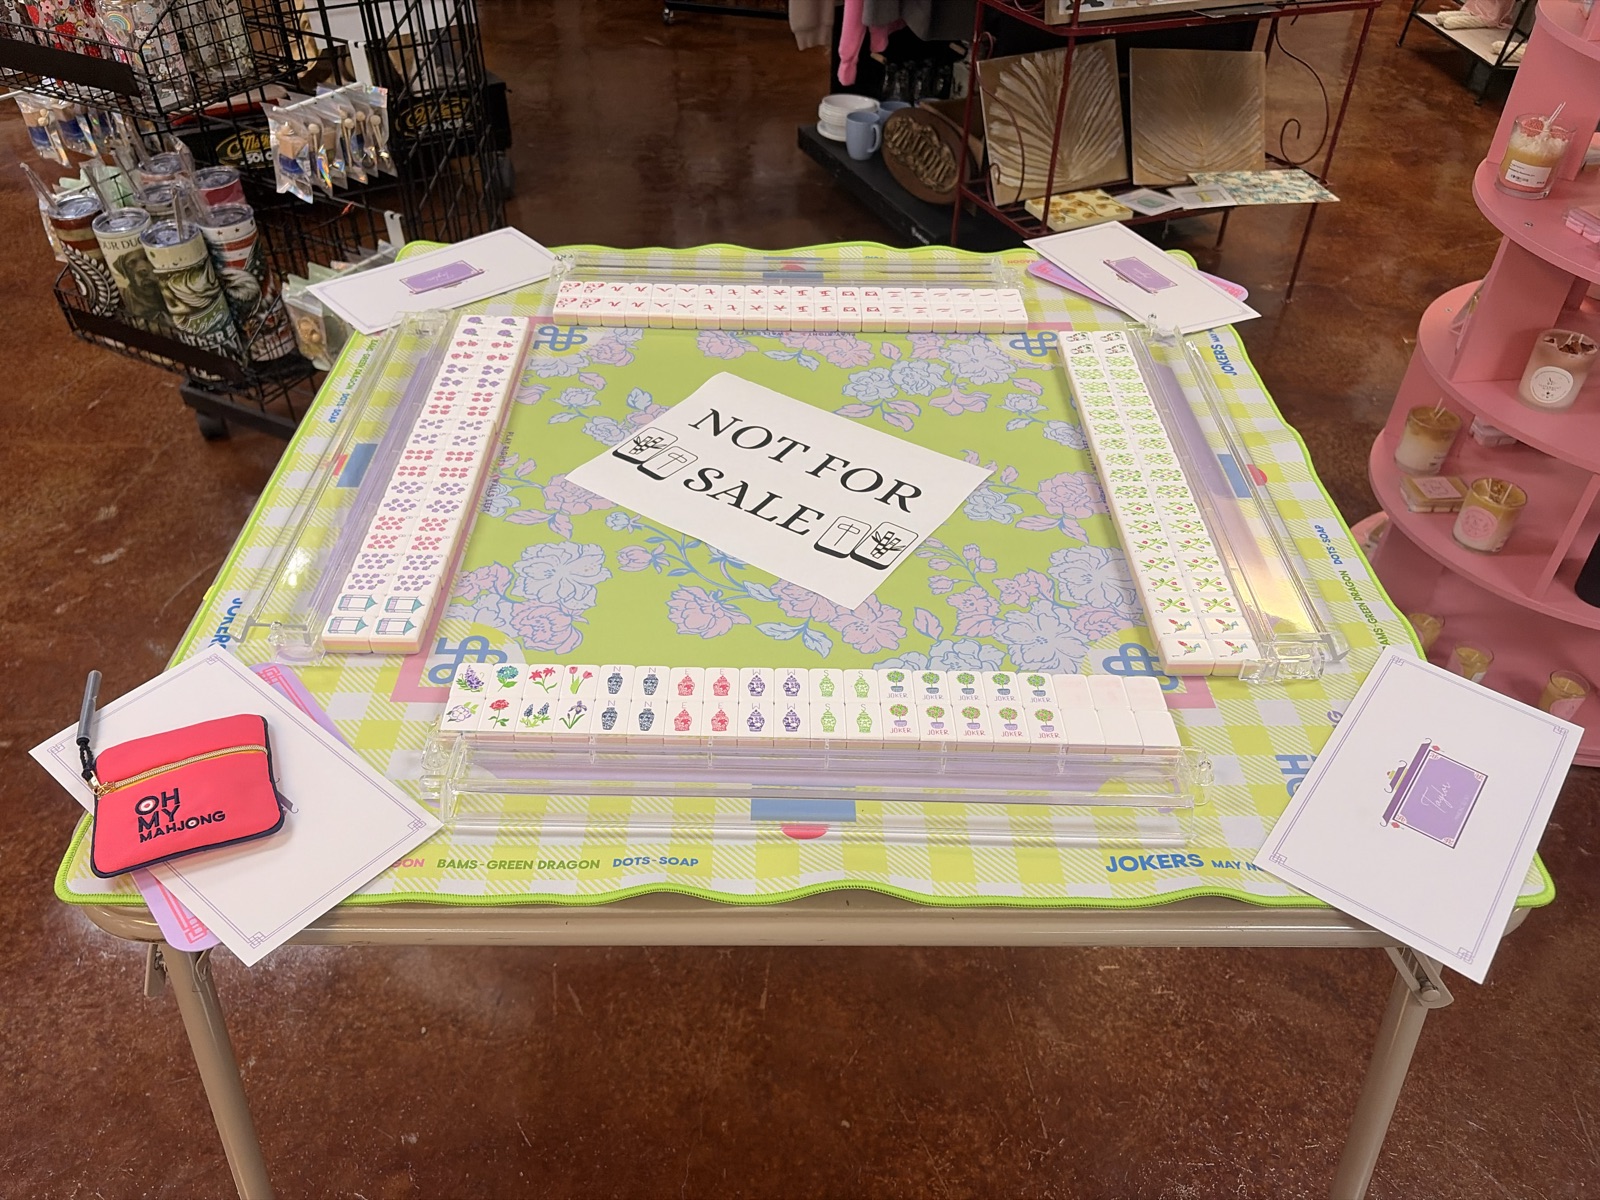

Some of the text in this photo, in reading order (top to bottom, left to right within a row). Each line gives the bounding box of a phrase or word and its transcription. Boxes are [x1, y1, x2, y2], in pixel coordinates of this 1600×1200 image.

[1210, 344, 1237, 376] JOKERS
[688, 408, 922, 513] NOT FOR
[683, 467, 825, 536] SALE
[1338, 570, 1363, 601] DRAGON
[135, 788, 180, 816] OH
[1421, 782, 1454, 813] Taylor
[137, 805, 180, 833] MY
[139, 810, 226, 843] MAHJONG
[536, 859, 600, 870] DRAGON
[1105, 853, 1205, 873] JOKERS
[1210, 859, 1241, 870] MAY
